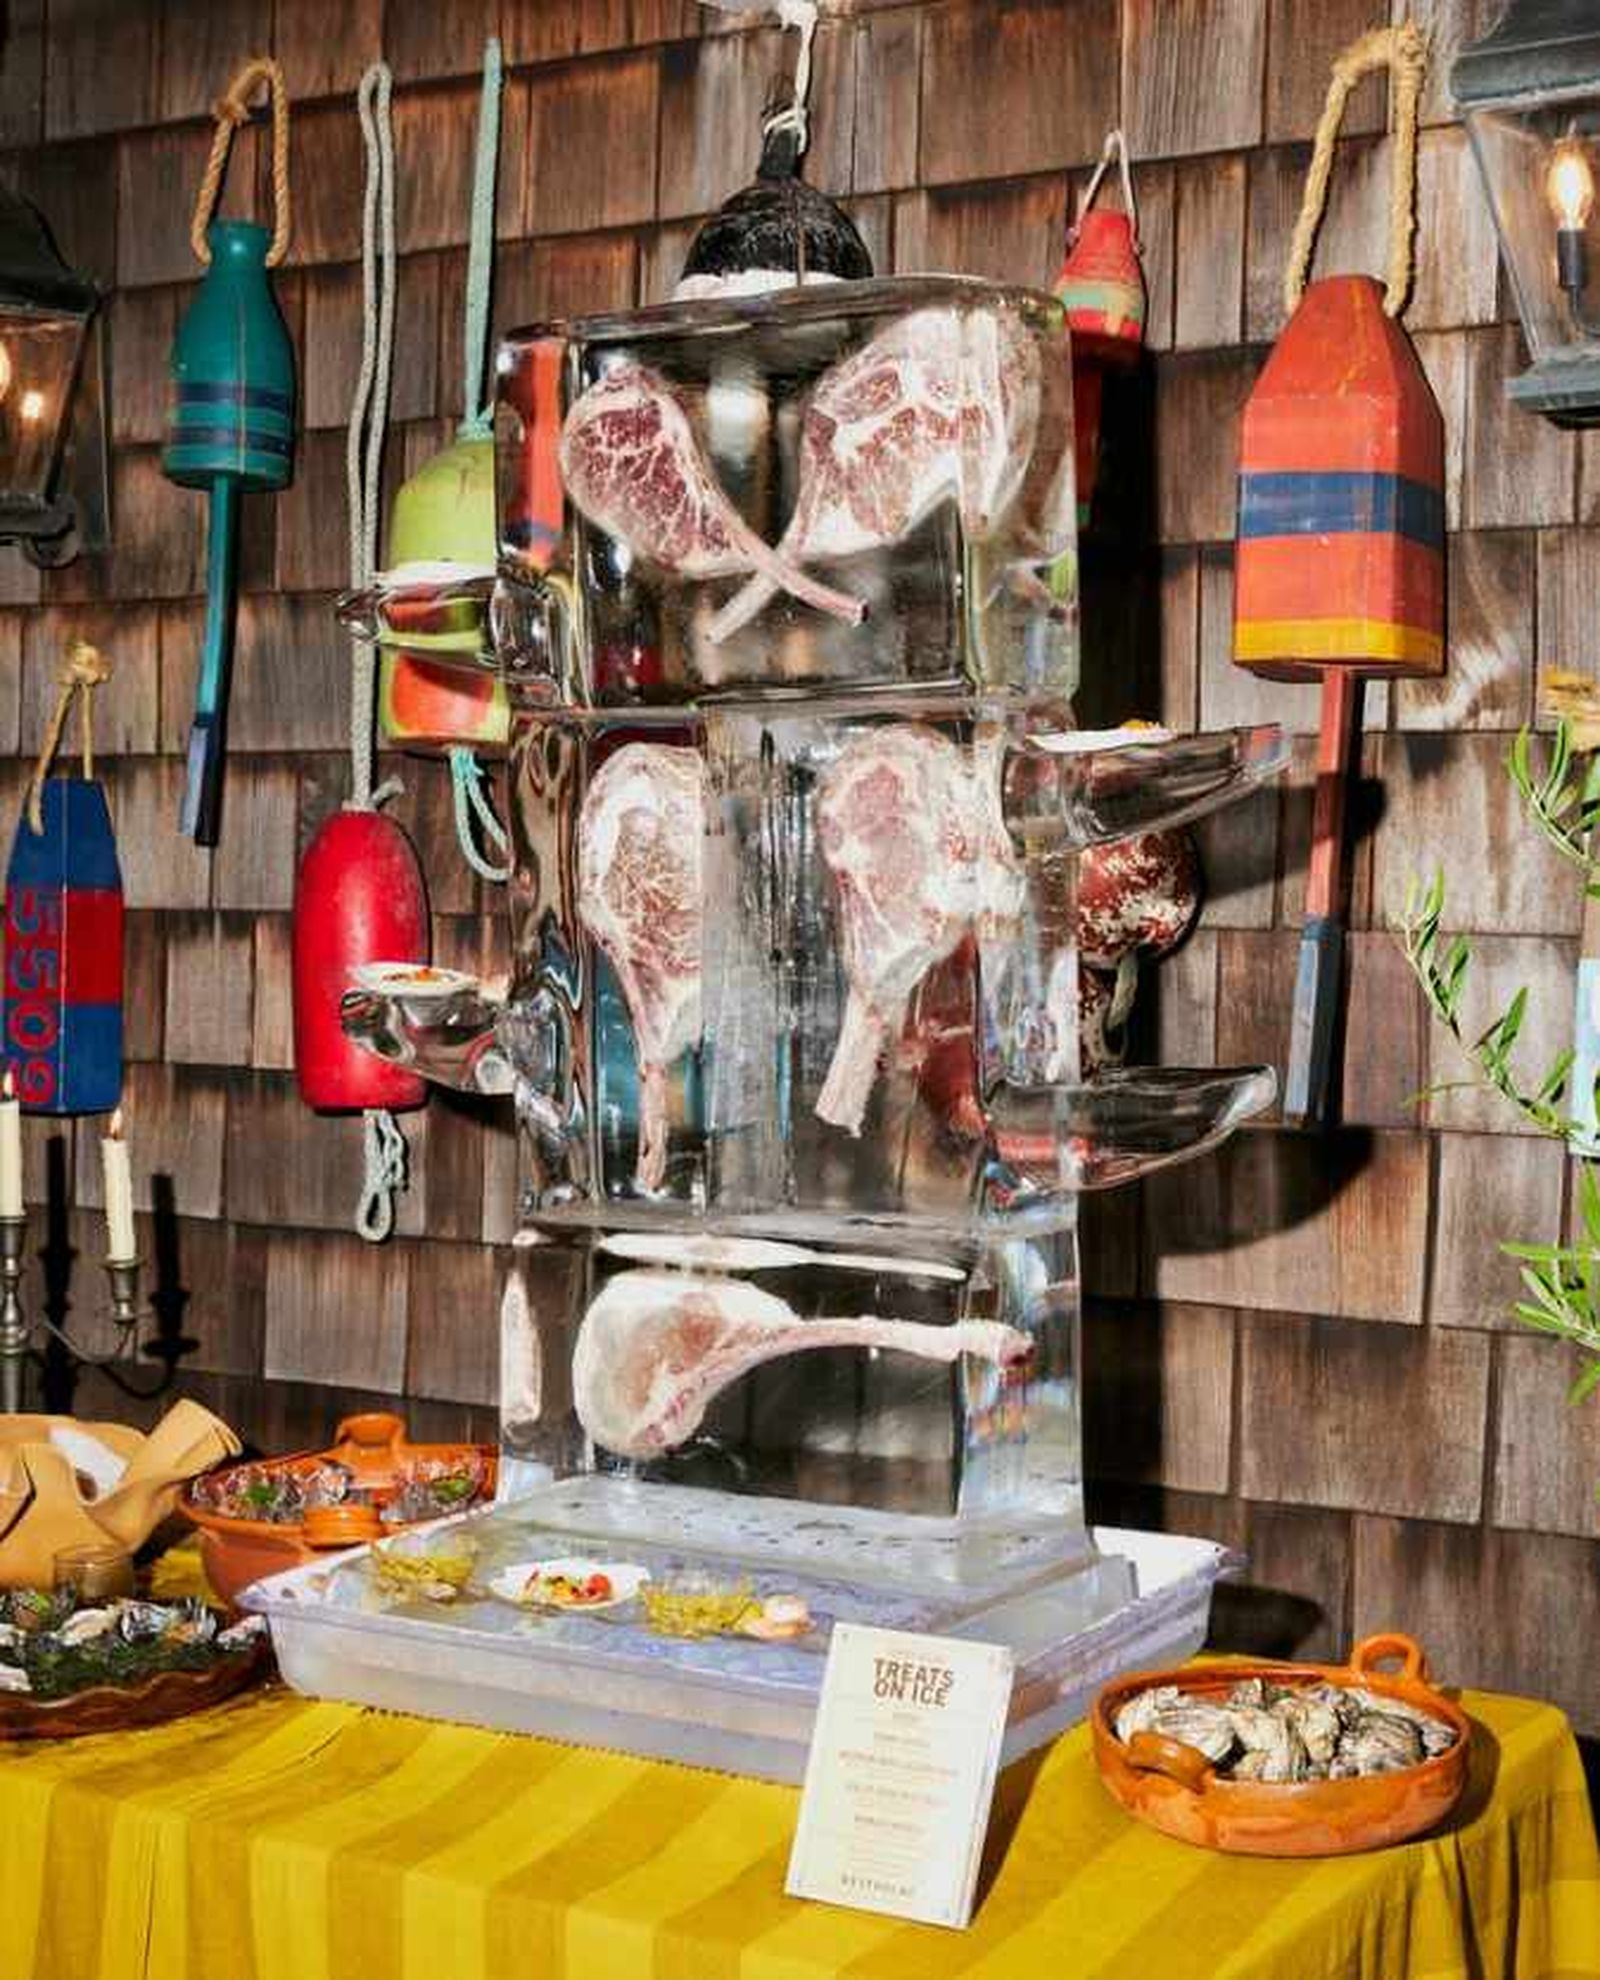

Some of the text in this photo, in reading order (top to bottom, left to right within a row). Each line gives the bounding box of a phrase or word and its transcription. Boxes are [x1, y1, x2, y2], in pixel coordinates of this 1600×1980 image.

[9, 889, 60, 1104] 5509
[873, 1657, 954, 1688] TREATS
[874, 1680, 950, 1707] ON ICE
